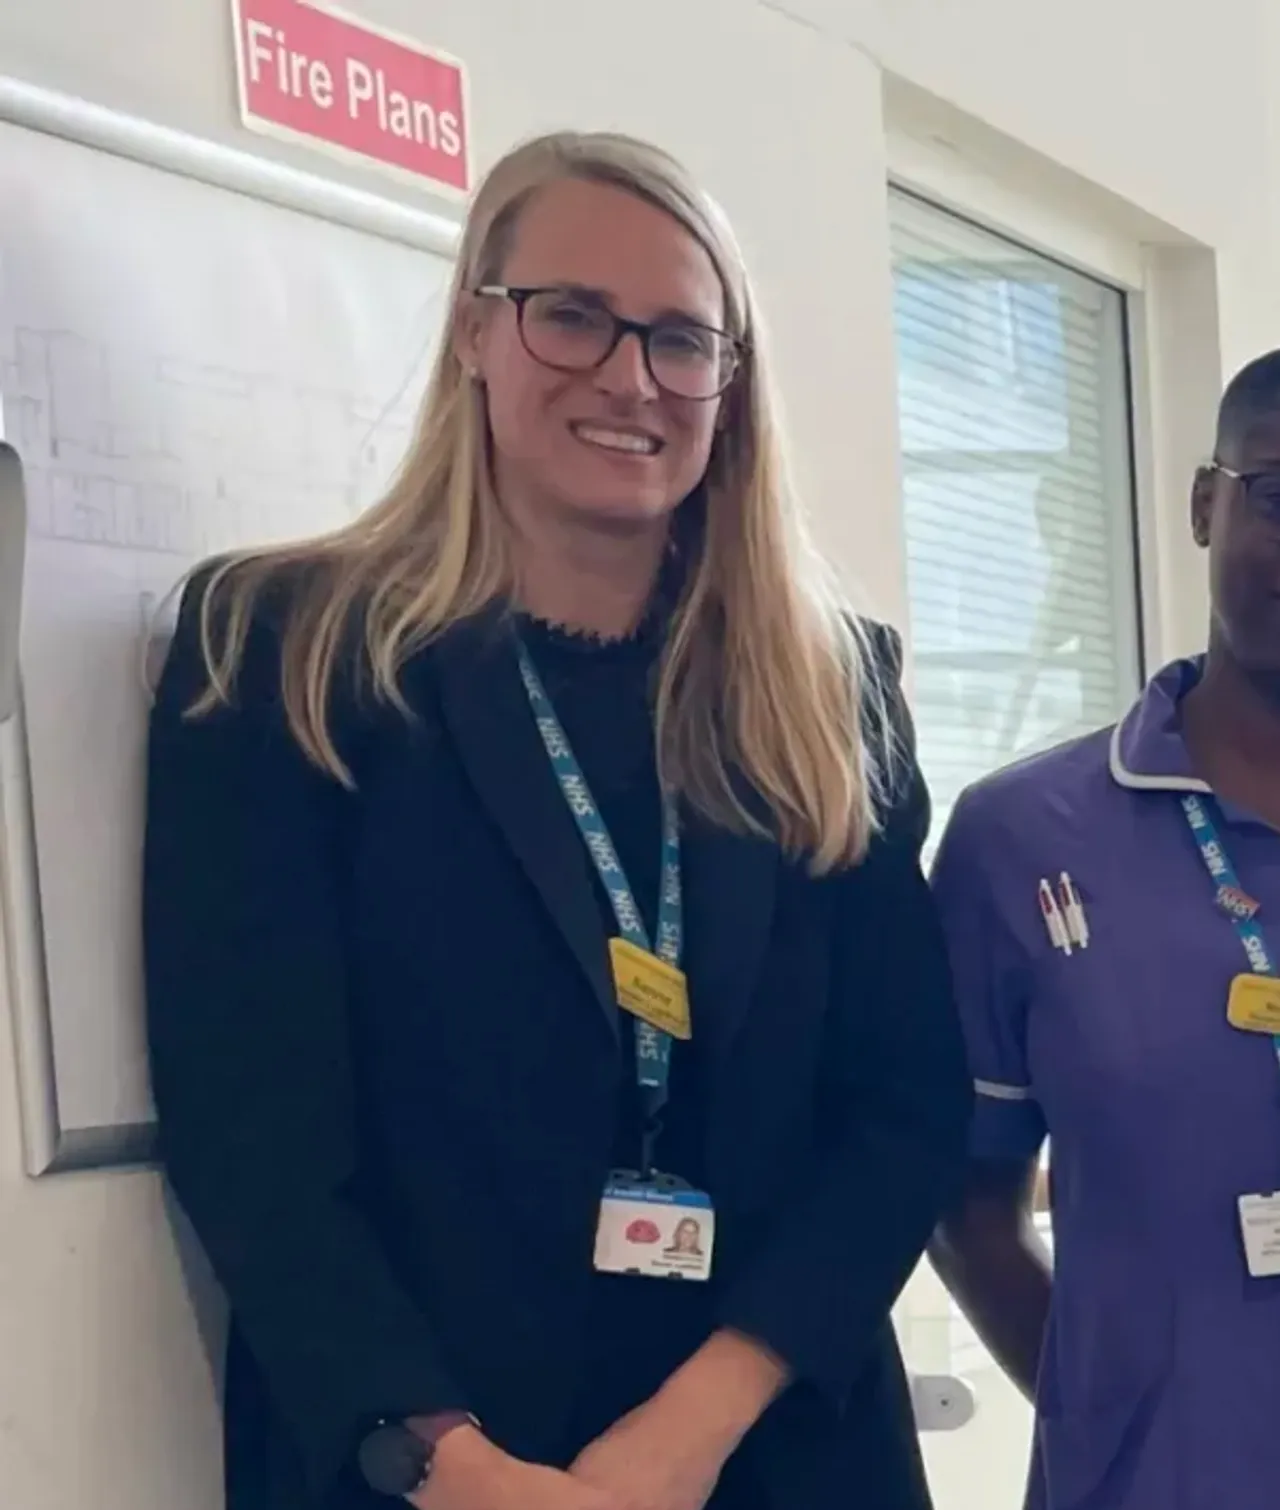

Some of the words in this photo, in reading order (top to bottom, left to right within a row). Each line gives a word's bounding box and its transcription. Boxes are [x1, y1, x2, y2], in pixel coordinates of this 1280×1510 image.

[247, 18, 334, 109] Fire
[346, 57, 461, 157] Plans
[536, 717, 569, 759] NHS
[560, 773, 595, 817] NHS
[585, 830, 620, 874] NHS
[610, 888, 641, 933] NHS
